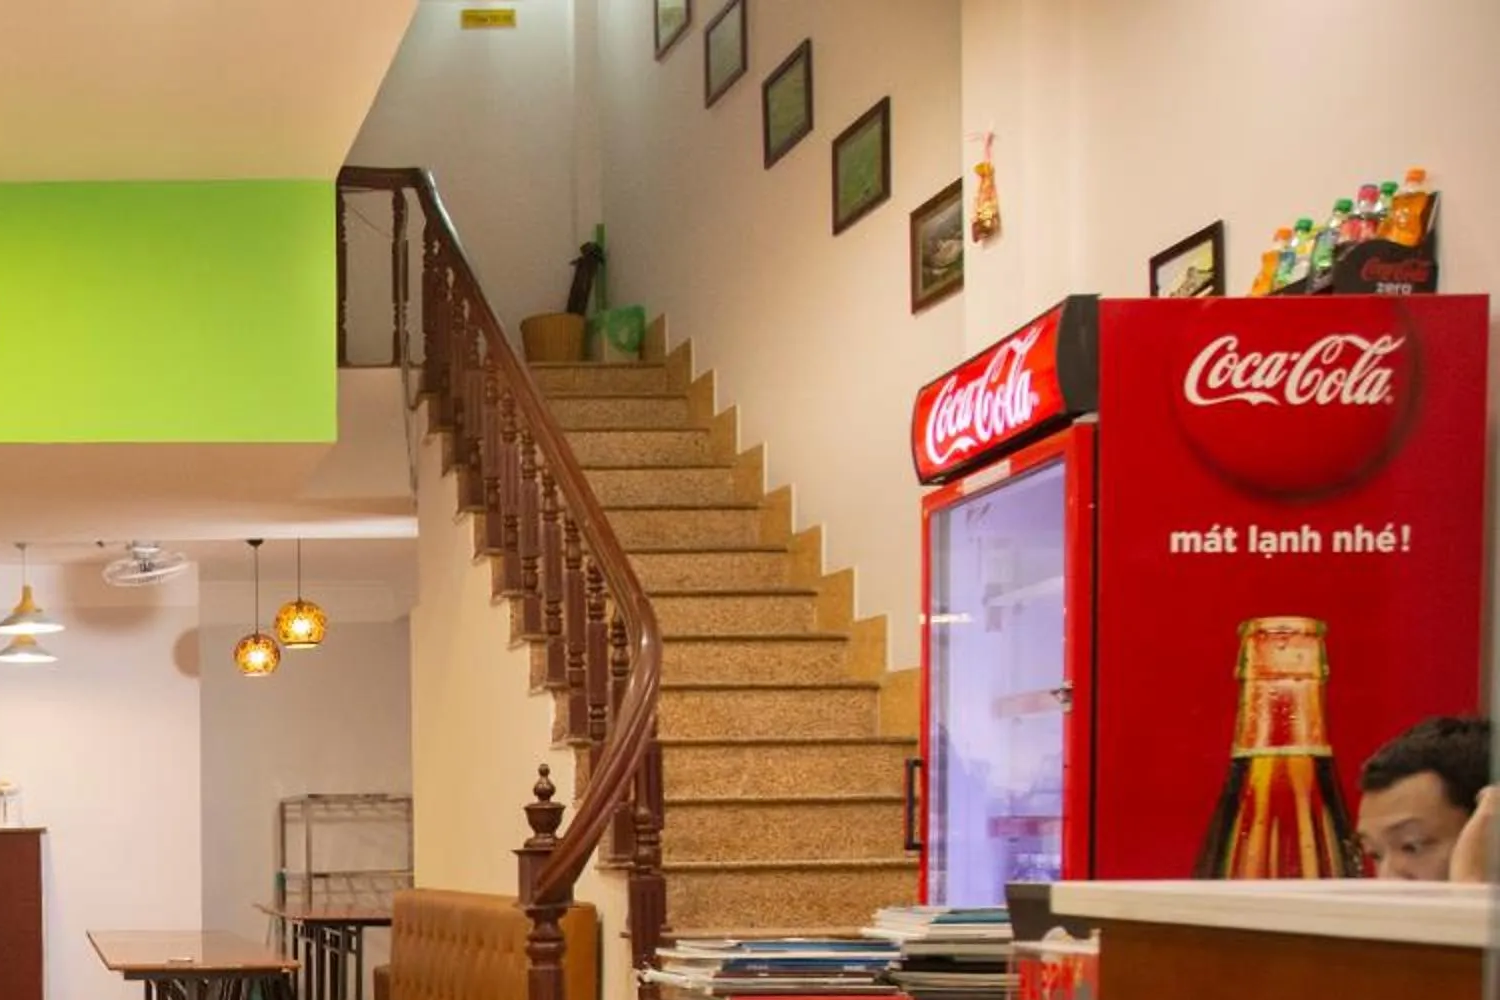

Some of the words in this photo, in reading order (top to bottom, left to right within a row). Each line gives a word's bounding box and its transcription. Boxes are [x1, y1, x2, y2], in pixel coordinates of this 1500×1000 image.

[1376, 282, 1412, 295] zero
[1184, 334, 1406, 406] Coca-Cola
[1170, 523, 1238, 553] mát
[1248, 524, 1322, 559] lạnh
[1332, 522, 1411, 553] nhé!
